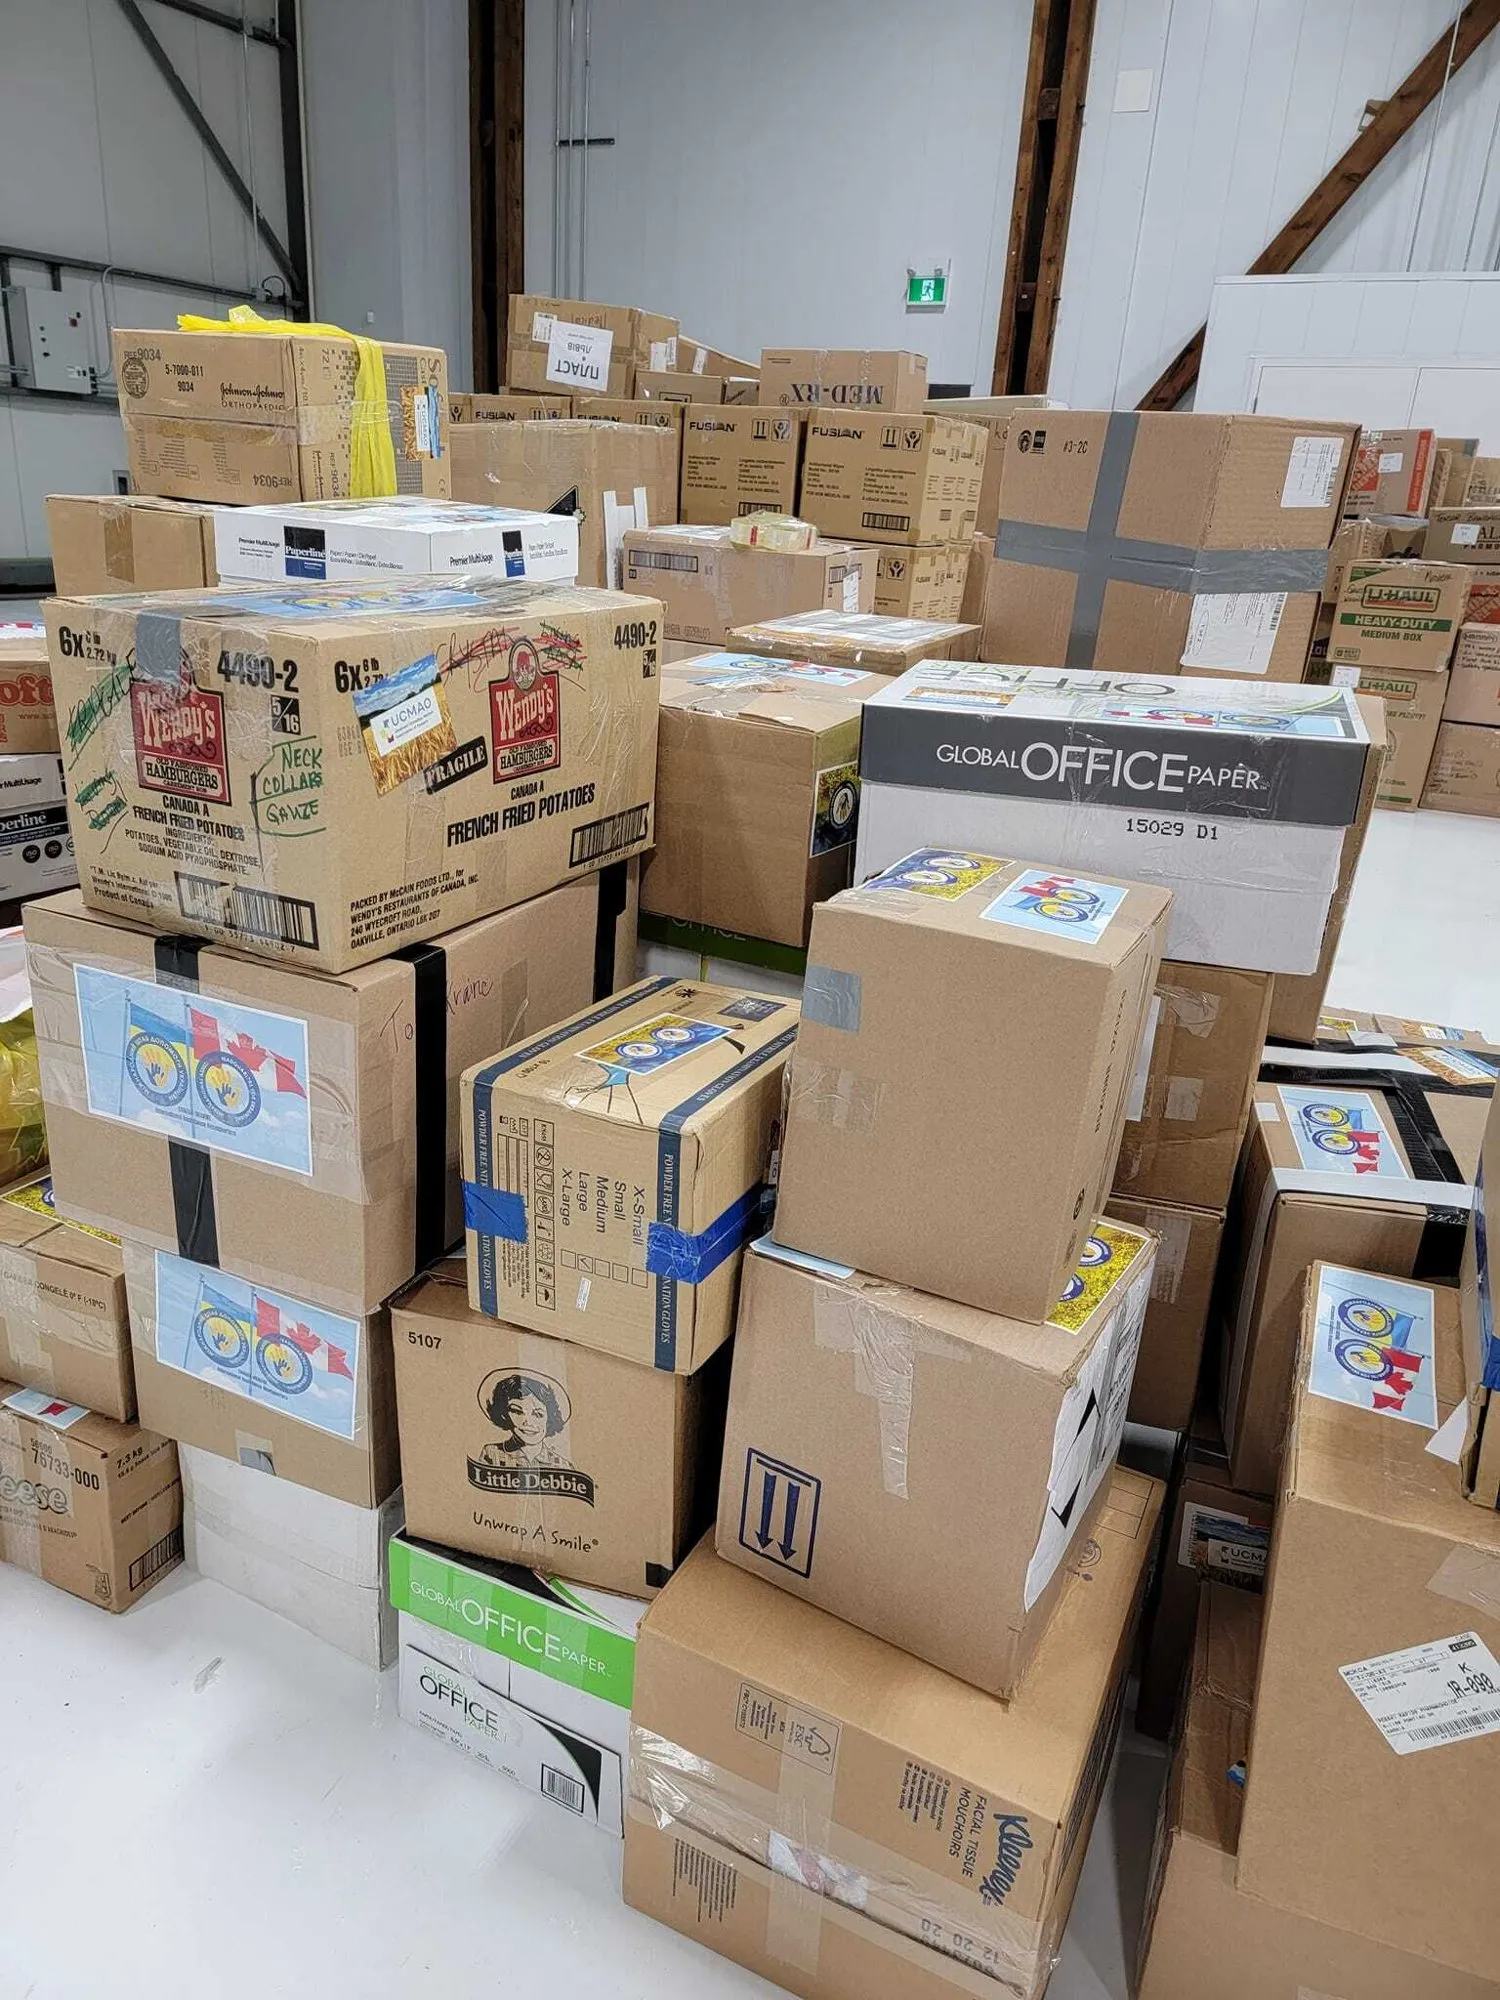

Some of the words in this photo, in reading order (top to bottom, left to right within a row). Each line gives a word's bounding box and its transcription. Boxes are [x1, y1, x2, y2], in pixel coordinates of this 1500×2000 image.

[165, 364, 204, 377] 5-7000-011
[555, 359, 600, 380] ПЛАСТ
[177, 381, 194, 392] 9034
[221, 401, 285, 411] ORTHOPAEDIC
[284, 545, 326, 559] Paperline
[449, 556, 468, 567] Premier
[614, 620, 657, 650] 4490-2
[1354, 615, 1437, 630] HEAVY-DUTY
[1360, 629, 1400, 640] MEDIUM
[1403, 631, 1424, 642] BOX
[59, 626, 85, 657] 6x
[86, 646, 105, 661] 2.72
[217, 650, 299, 693] 4490-2
[334, 660, 362, 694] 6x
[138, 692, 216, 748] Wendy's
[390, 697, 432, 728] UCMAO
[495, 684, 555, 742] Wendy's
[281, 744, 323, 772] NECK
[425, 746, 487, 789] FRAGILE
[500, 743, 553, 770] HAMBURGERS
[936, 743, 1020, 769] GLOBAL
[1021, 741, 1187, 793] OFFICE
[1187, 763, 1262, 791] PAPER
[145, 762, 218, 790] HAMBURGERS
[510, 783, 538, 800] CANADA
[539, 780, 545, 792] A
[162, 795, 201, 816] CANADA
[202, 805, 210, 817] A
[266, 801, 320, 824] GAUZE
[447, 811, 499, 847] FRENCH
[502, 802, 535, 830] FRIED
[538, 782, 596, 819] POTATOES
[0, 813, 47, 833] perline
[132, 806, 168, 826] FRENCH
[170, 813, 195, 830] FRIED
[196, 819, 246, 841] POTATOES
[1126, 818, 1184, 837] 15029
[1197, 824, 1219, 841] D1
[125, 829, 161, 845] POTATOES,
[163, 835, 203, 853] VEGETABLE
[220, 849, 261, 868] DEXTROSE,
[138, 842, 166, 858] SODIUM
[167, 848, 184, 861] ACID
[94, 887, 118, 902] Product
[350, 893, 378, 912] PACKED
[379, 891, 389, 902] BY
[415, 876, 437, 892] FOODS
[350, 907, 383, 925] WENDY'S
[383, 891, 431, 916] RESTAURANTS
[431, 887, 440, 899] OF
[440, 879, 467, 897] CANADA,
[468, 873, 480, 886] INC.
[350, 931, 385, 949] OAKVILLE,
[386, 920, 414, 938] ONTARIO
[364, 915, 400, 935] WYECROFT
[400, 907, 422, 922] ROAD,
[479, 1109, 488, 1144] POWDER
[480, 1146, 489, 1166] FREE
[663, 1154, 674, 1191] POWDER
[560, 1168, 572, 1226] X-Large
[577, 1172, 590, 1211] Large
[596, 1176, 609, 1233] Medium
[614, 1181, 626, 1220] Small
[663, 1192, 673, 1214] FREE
[632, 1186, 644, 1246] X-Small
[483, 1259, 491, 1290] GLOVES
[661, 1278, 672, 1311] INATION
[408, 1332, 442, 1350] 5107
[661, 1311, 670, 1344] GLOVES
[31, 1448, 100, 1491] 76733-000
[116, 1454, 132, 1470] 7.3
[132, 1445, 144, 1461] kg
[0, 1475, 68, 1515] eese
[472, 1468, 520, 1489] Little
[524, 1475, 587, 1495] Debbie
[473, 1511, 527, 1540] Unwrap
[532, 1526, 546, 1541] A
[1230, 1547, 1267, 1563] UCM
[410, 1581, 460, 1611] GLOBAL
[461, 1598, 561, 1662] OFFICE
[561, 1646, 607, 1674] PAPER
[422, 1665, 468, 1694] GLOBAL
[1458, 1662, 1471, 1674] K
[1447, 1672, 1494, 1699] 1R-090
[419, 1675, 499, 1729] OFFICE
[948, 1786, 971, 1859] MOUCHOIRS
[969, 1795, 988, 1834] FACIAL
[962, 1838, 981, 1879] TISSUE
[977, 1813, 1033, 1907] Kleenex
[919, 1917, 940, 1937] 20
[951, 1933, 973, 1953] 20
